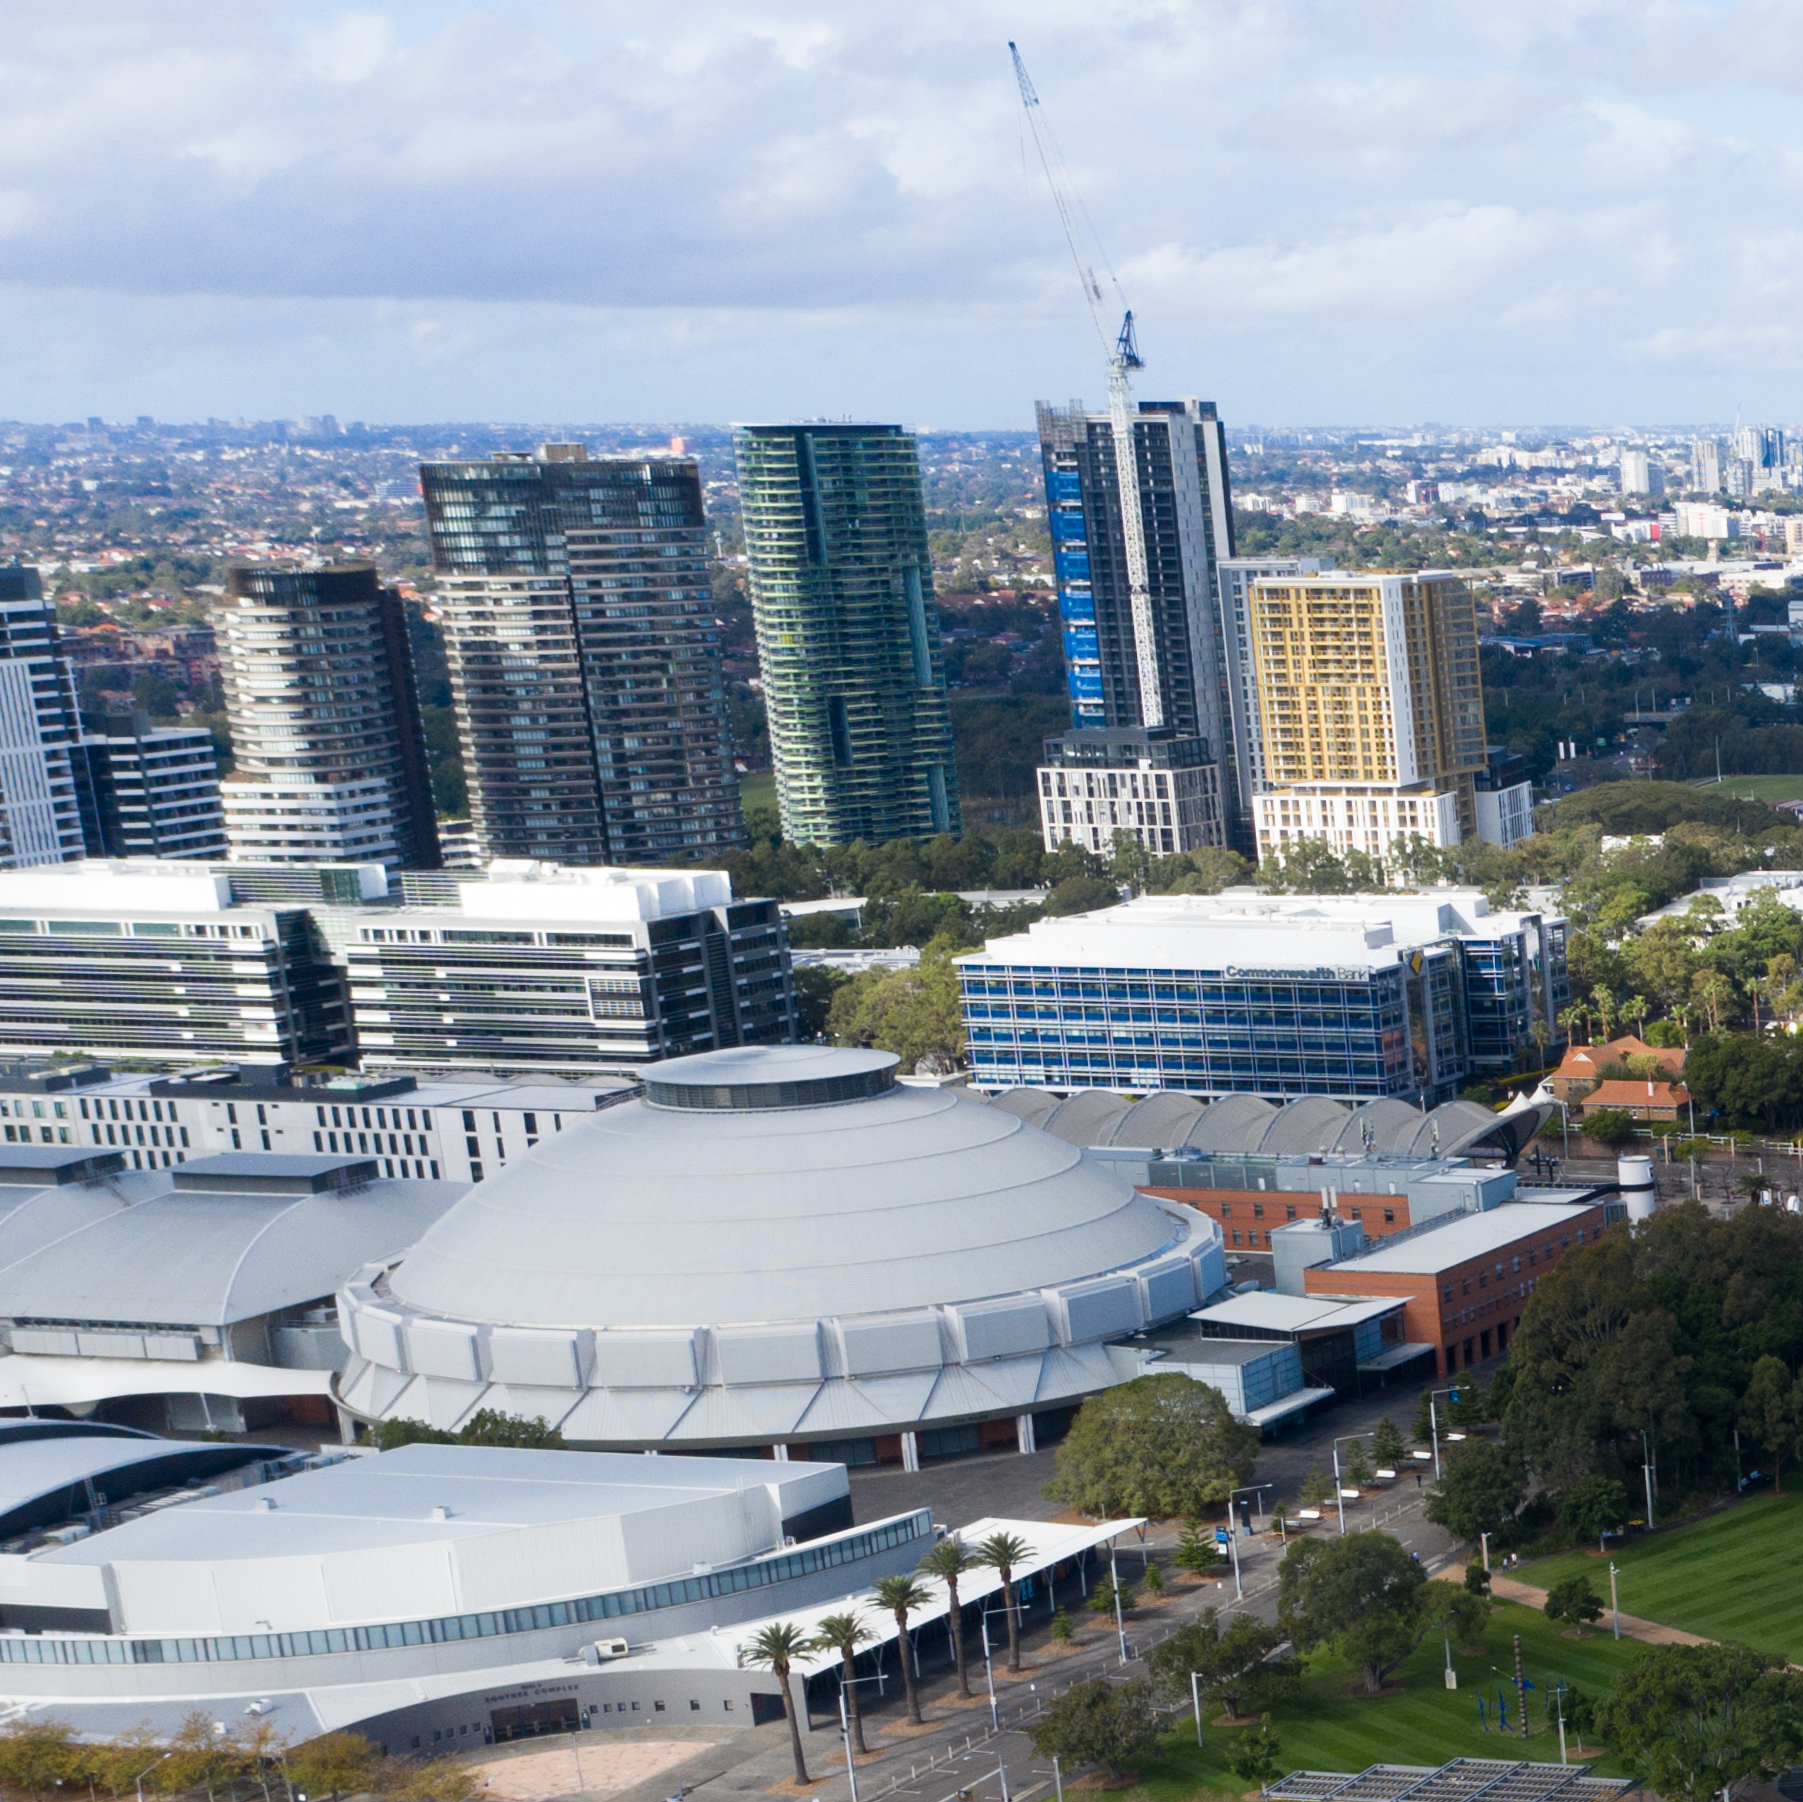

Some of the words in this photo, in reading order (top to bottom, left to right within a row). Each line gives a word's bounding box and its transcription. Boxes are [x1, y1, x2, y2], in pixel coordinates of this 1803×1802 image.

[1226, 965, 1335, 979] Commonwealth
[1337, 966, 1367, 980] Bank
[534, 1684, 579, 1696] COMPLEX
